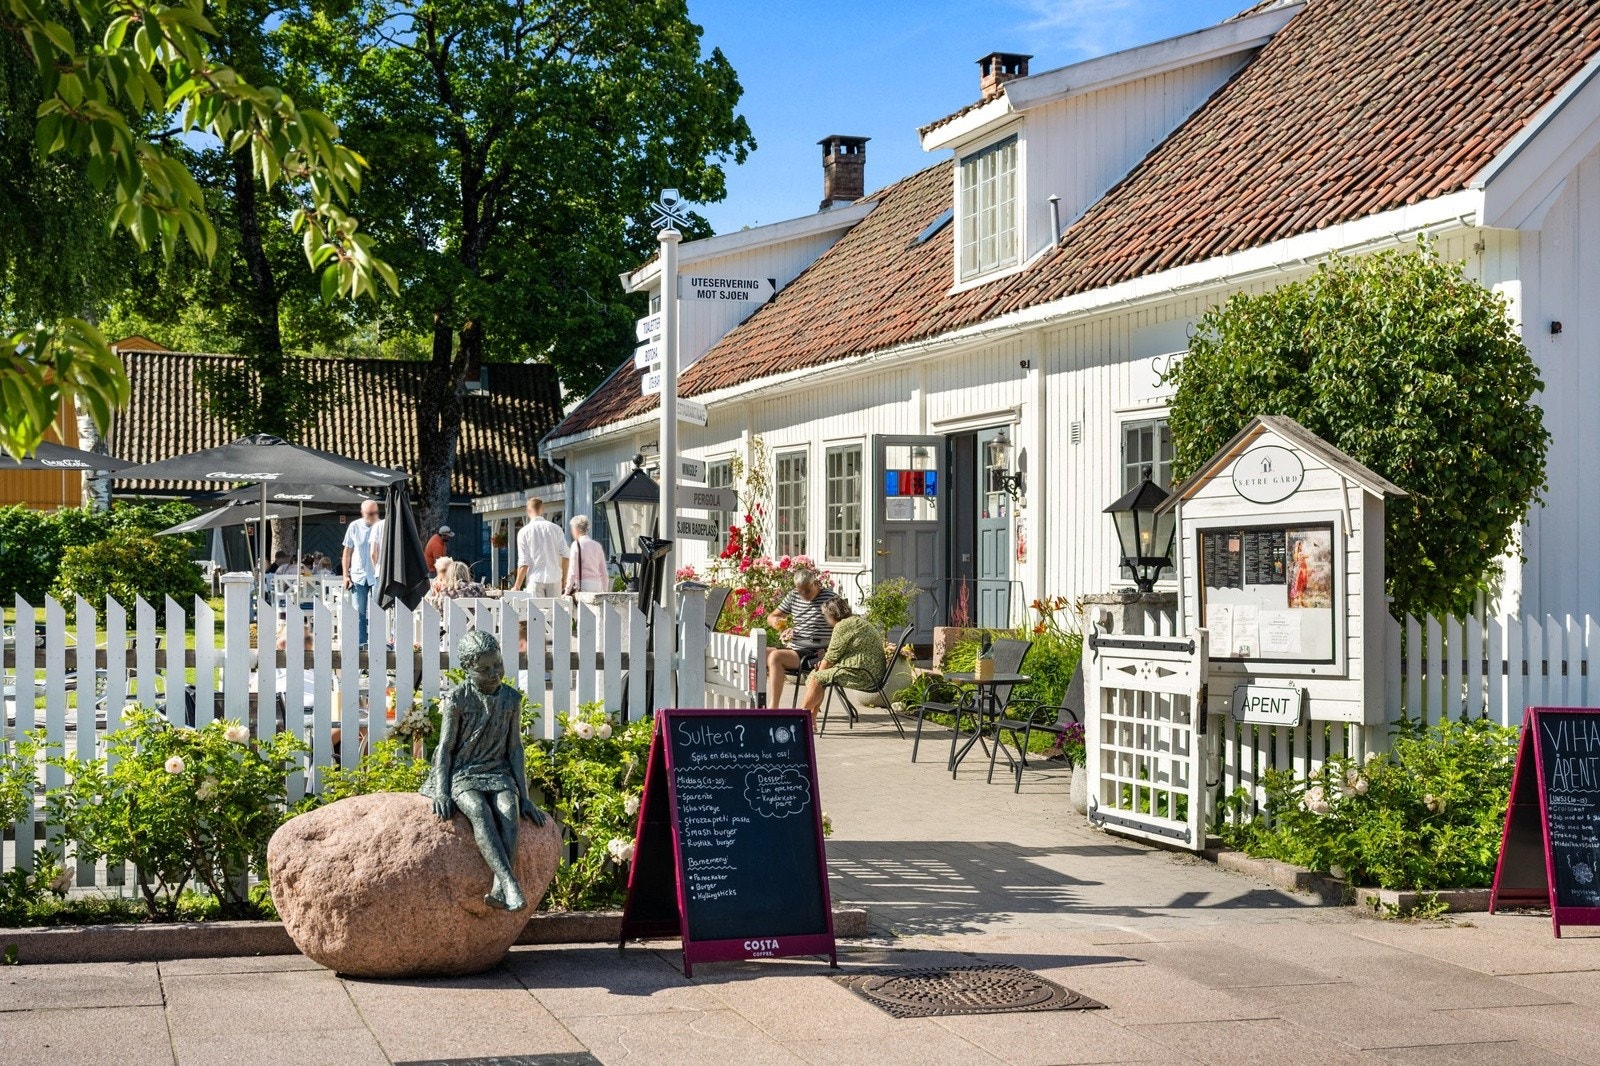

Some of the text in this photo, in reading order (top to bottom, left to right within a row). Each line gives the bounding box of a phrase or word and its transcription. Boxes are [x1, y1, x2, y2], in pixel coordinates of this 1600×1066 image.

[691, 277, 759, 290] UTESERVERING
[697, 289, 749, 301] MOT SJØEN
[694, 493, 721, 507] PERGOLA
[692, 522, 717, 537] BADEPLASS
[710, 751, 719, 759] en
[762, 750, 772, 759] hos
[685, 828, 738, 838] Smash burger
[716, 839, 736, 848] burger
[744, 939, 780, 951] COSTA
